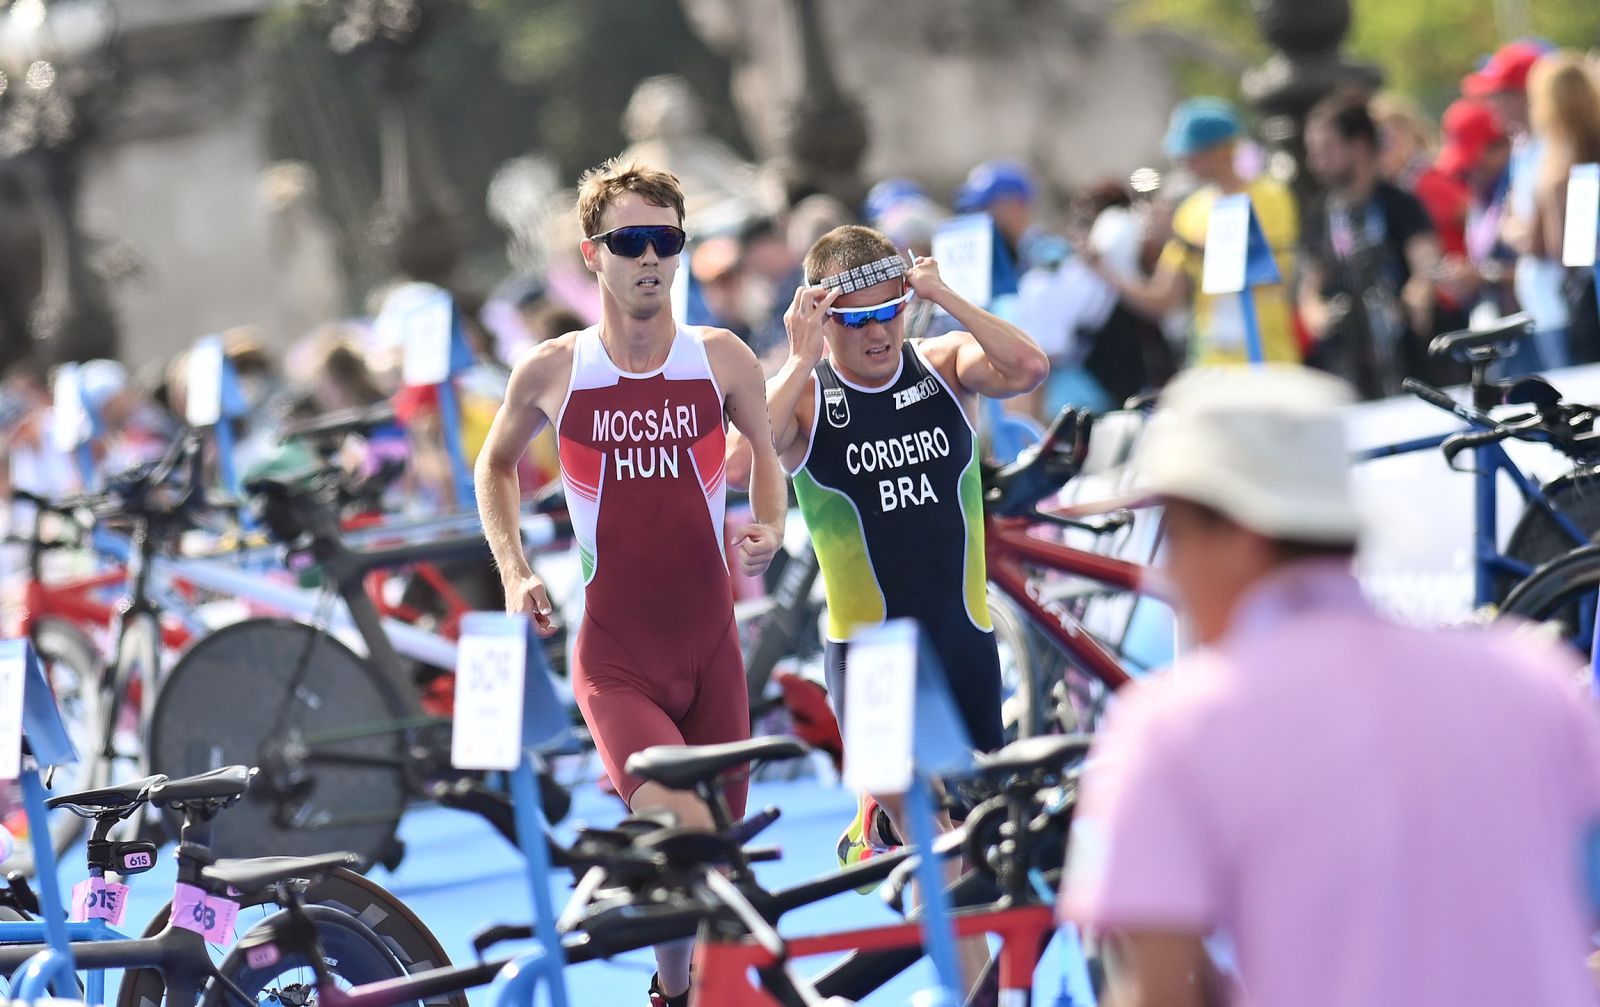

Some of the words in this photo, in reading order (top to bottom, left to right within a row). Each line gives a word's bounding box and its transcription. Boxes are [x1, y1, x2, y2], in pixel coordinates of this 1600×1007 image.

[592, 399, 698, 442] MOCSÁRI
[614, 445, 679, 481] HUN
[846, 426, 950, 475] CORDEIRO
[878, 473, 939, 512] BRA
[129, 855, 148, 867] 615
